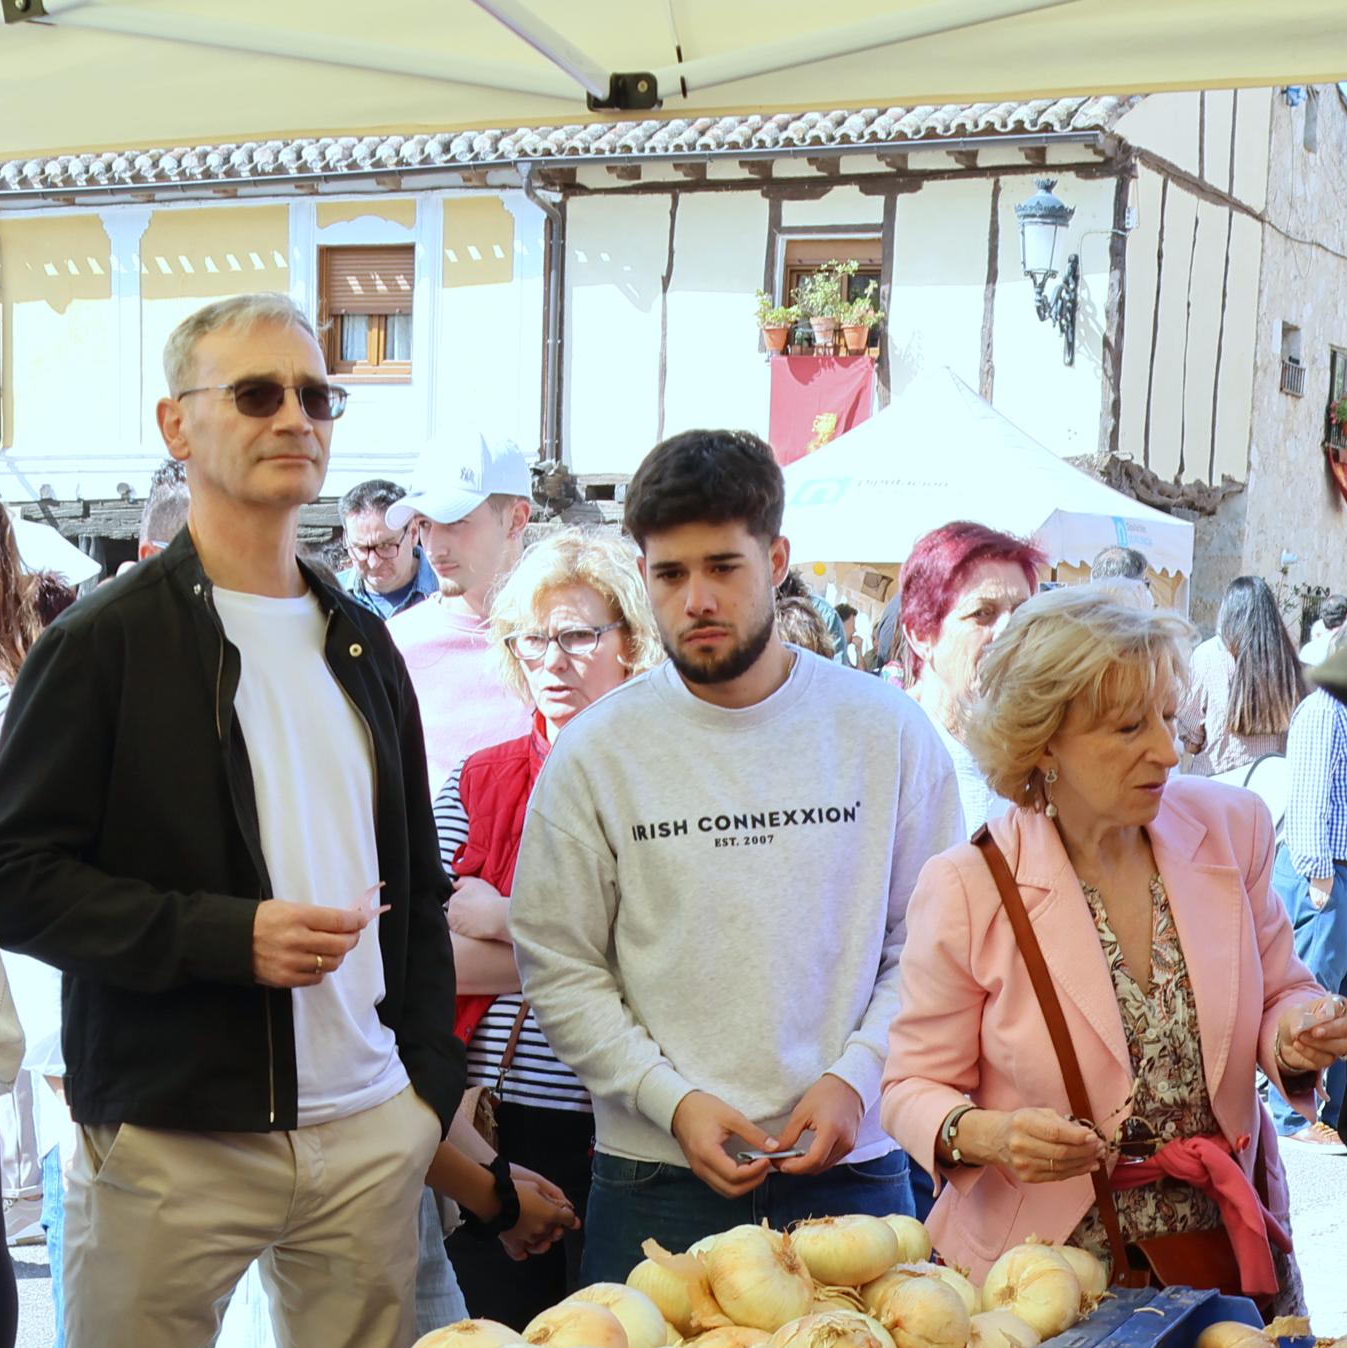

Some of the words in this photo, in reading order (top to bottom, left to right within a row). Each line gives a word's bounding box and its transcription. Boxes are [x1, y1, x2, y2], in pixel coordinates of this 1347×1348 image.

[631, 819, 688, 841] IRISH
[714, 837, 740, 848] EST.
[743, 834, 775, 846] 2007
